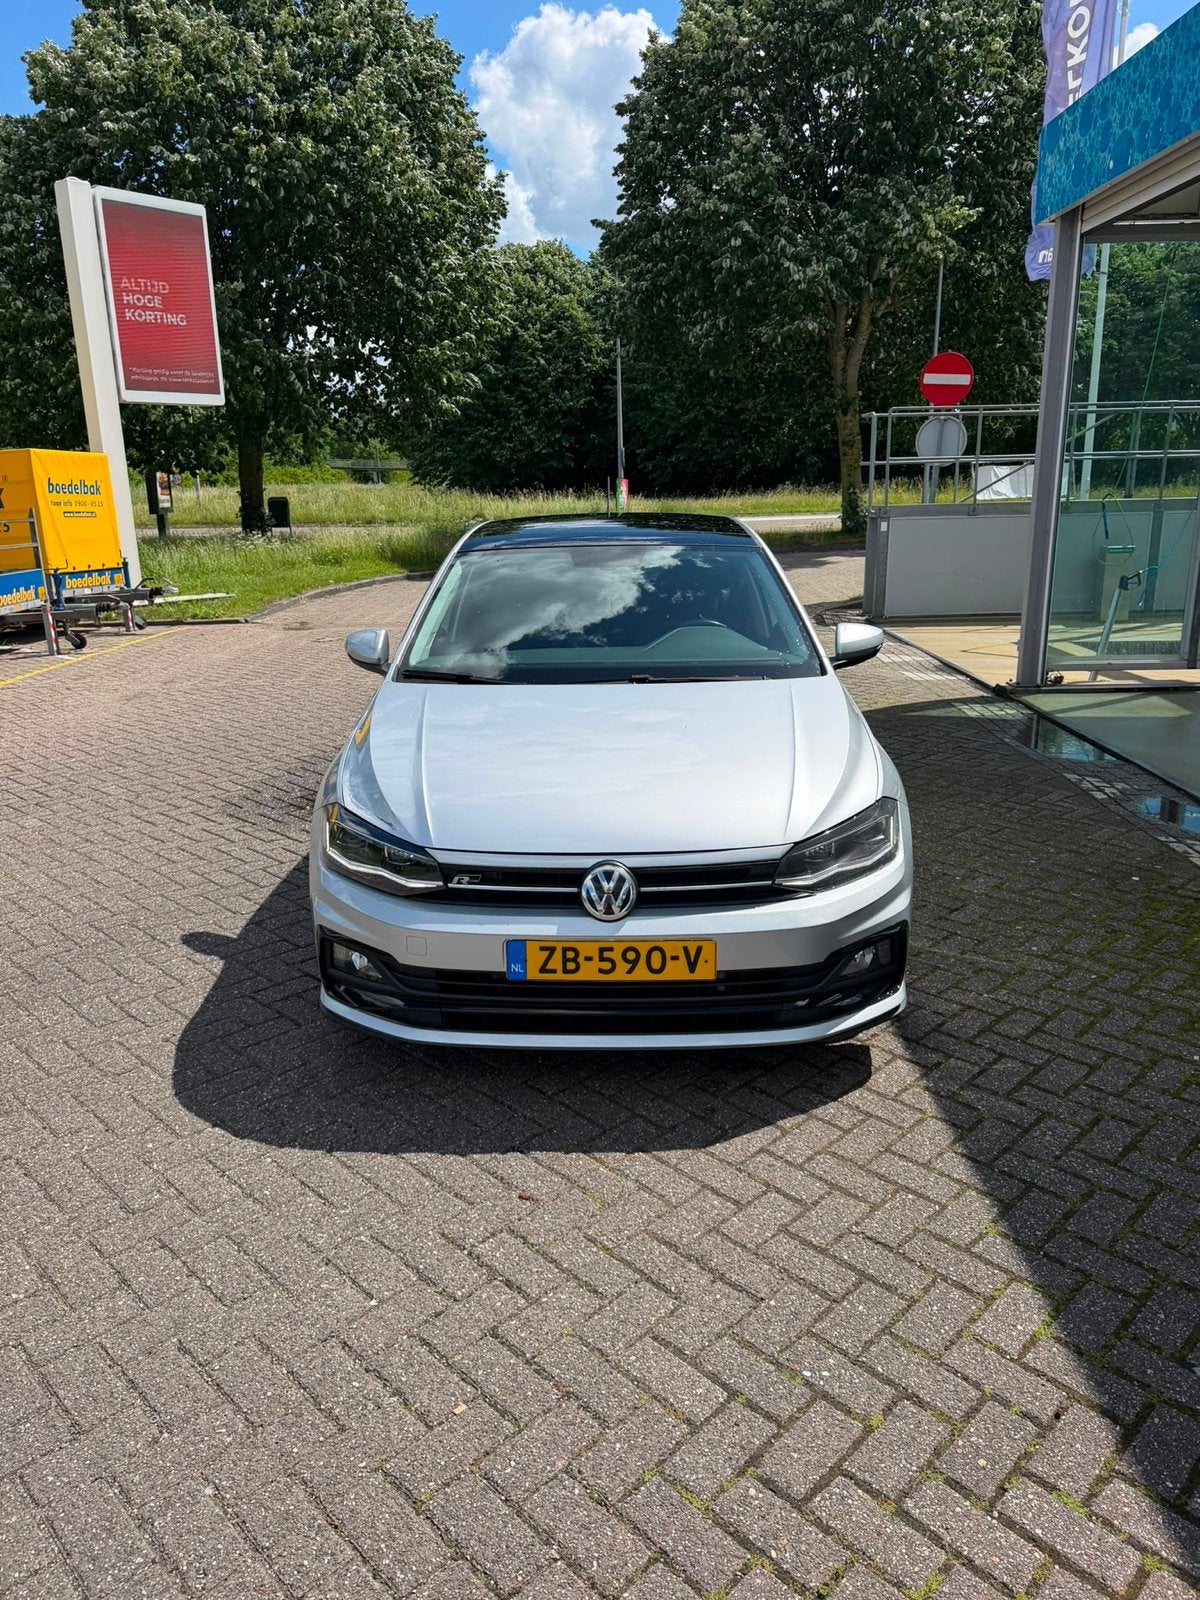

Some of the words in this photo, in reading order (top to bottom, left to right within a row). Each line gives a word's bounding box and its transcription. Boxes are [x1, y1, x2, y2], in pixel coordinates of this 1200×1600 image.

[120, 277, 169, 293] ALTIJD
[122, 293, 163, 308] HOGE
[125, 309, 187, 325] KORTING
[48, 477, 101, 495] boedelbak
[66, 571, 110, 589] boedelbak
[510, 964, 524, 973] NL
[538, 946, 703, 975] ZB-590-V
